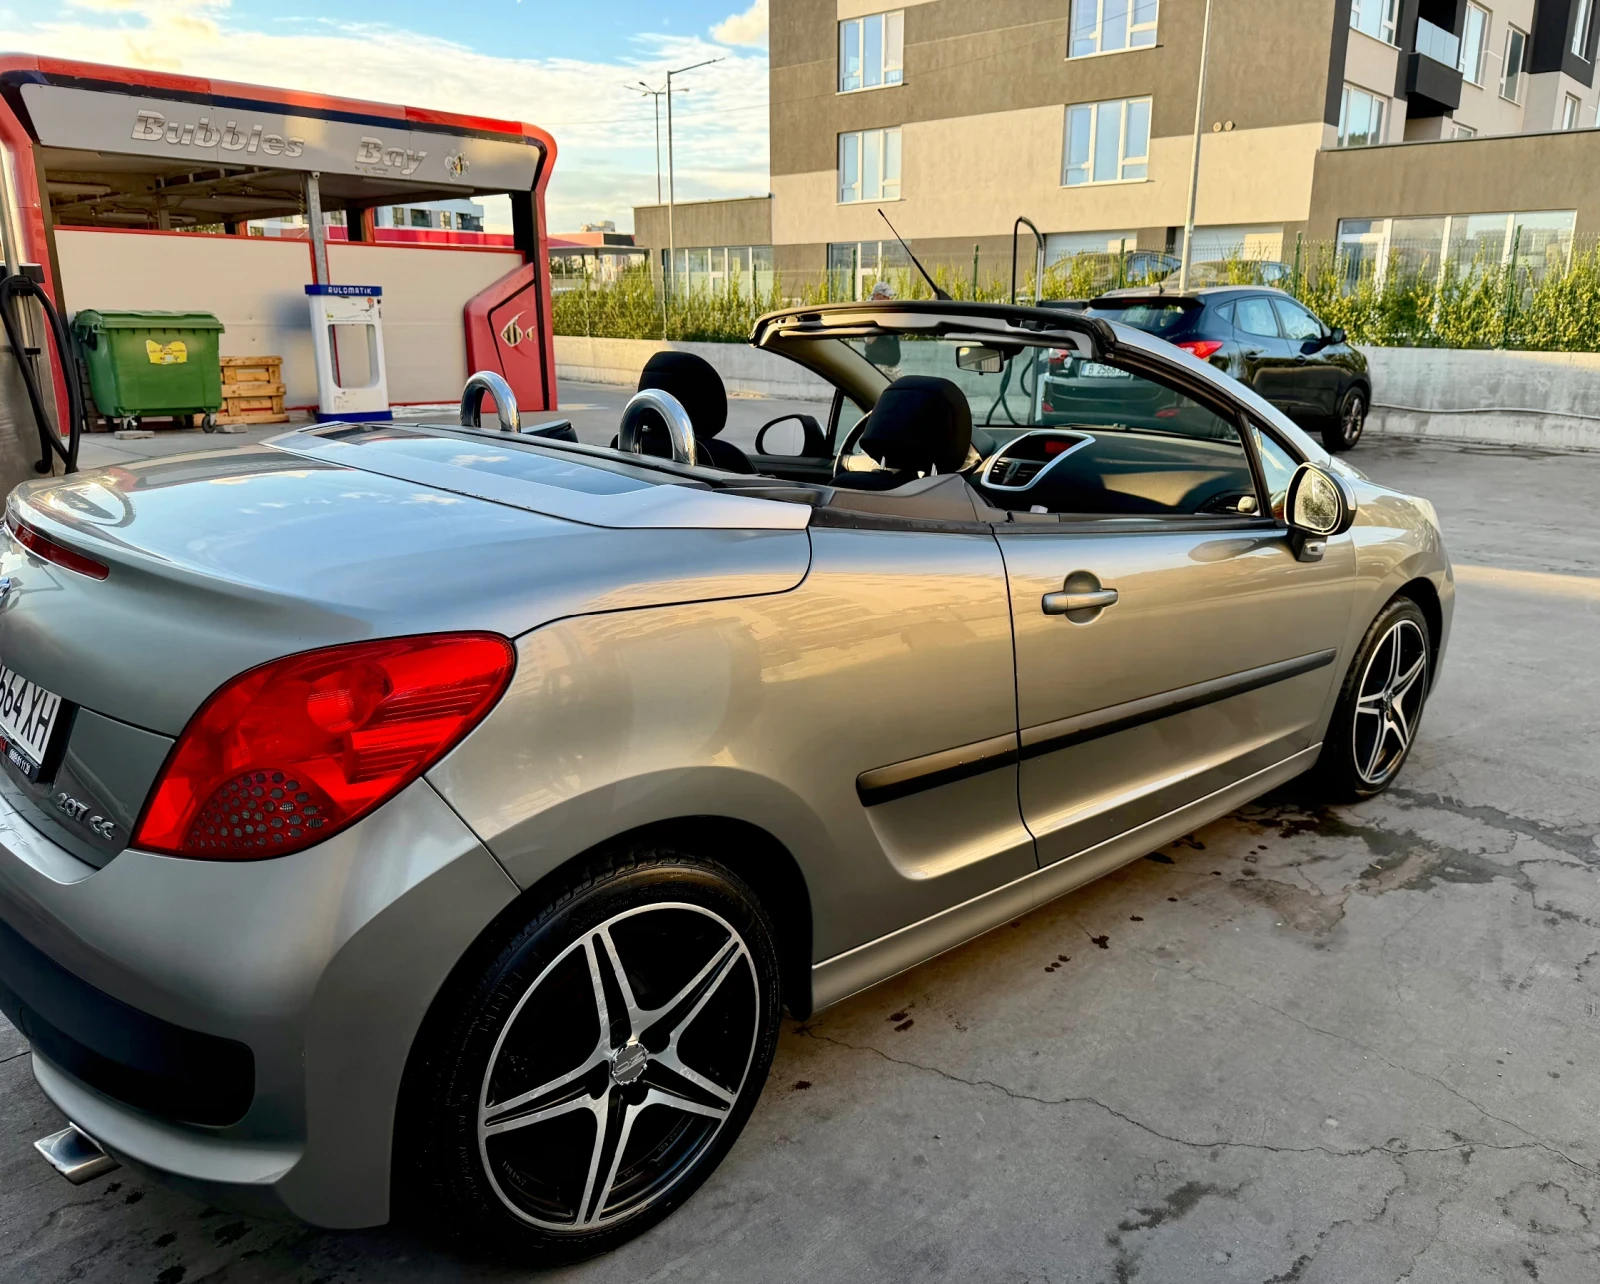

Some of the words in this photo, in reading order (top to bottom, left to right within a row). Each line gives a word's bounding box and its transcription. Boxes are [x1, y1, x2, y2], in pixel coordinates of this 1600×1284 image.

[131, 109, 305, 158] Bubbles
[355, 136, 428, 175] Bay
[56, 792, 89, 821] 207
